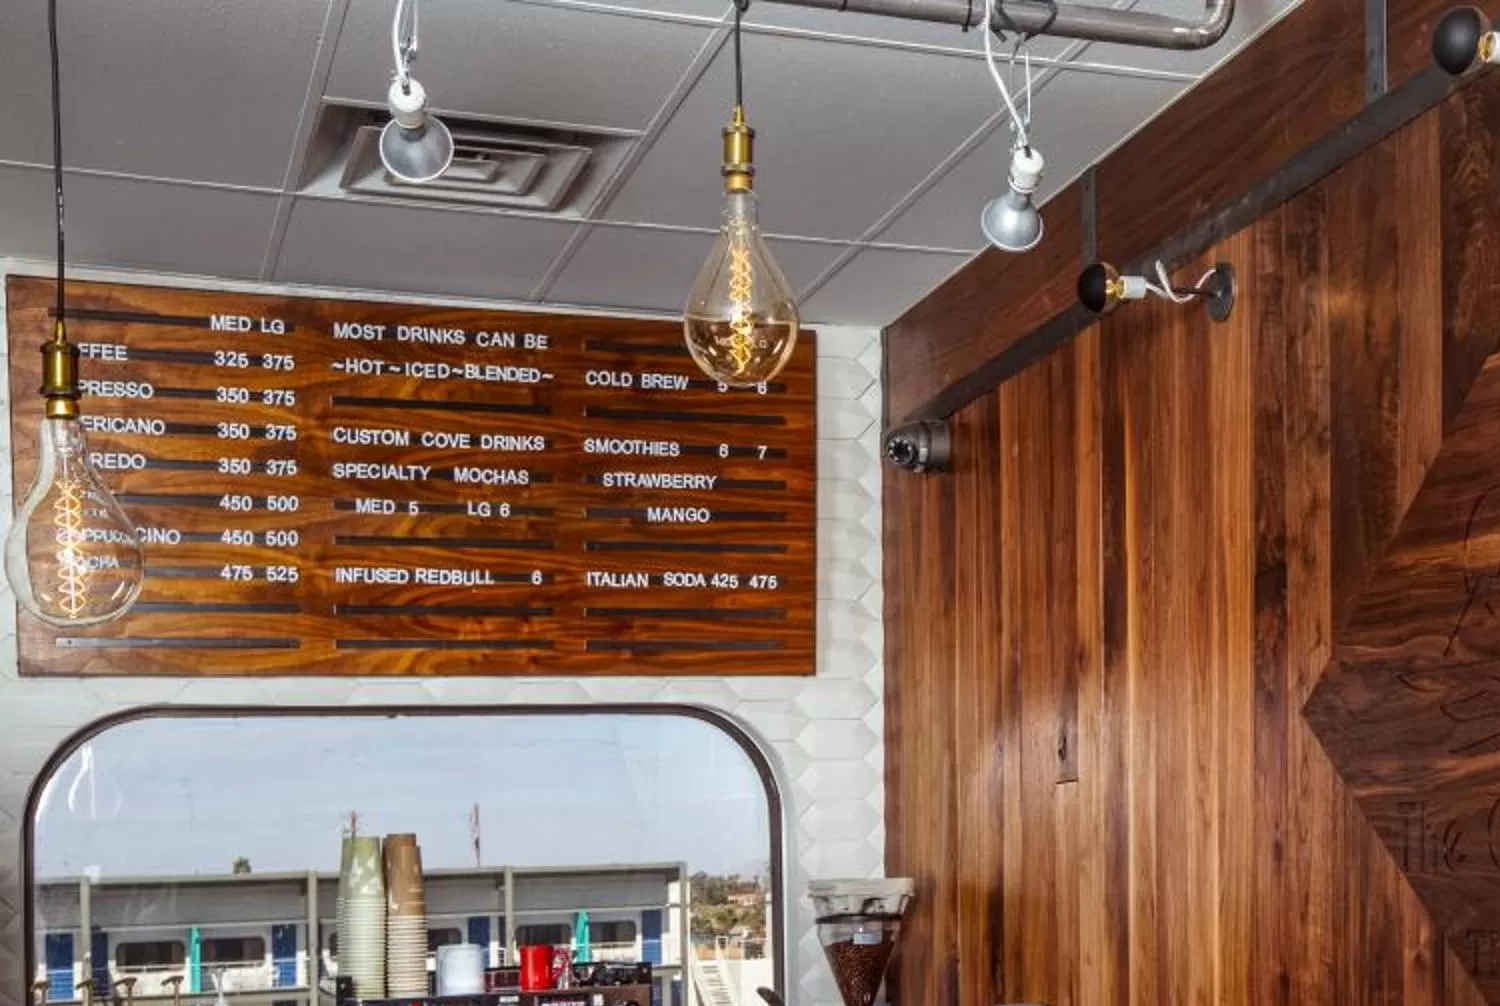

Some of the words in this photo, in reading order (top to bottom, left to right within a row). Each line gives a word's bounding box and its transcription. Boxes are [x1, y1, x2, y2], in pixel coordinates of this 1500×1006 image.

[210, 314, 250, 332] MED
[260, 317, 285, 335] LG
[333, 322, 386, 341] MOST
[397, 325, 466, 345] DRINKS
[475, 331, 516, 348] CAN
[524, 333, 548, 350] BE
[78, 342, 128, 361] FFEE
[213, 350, 249, 368] 325
[262, 353, 295, 371] 375
[584, 369, 633, 388] COLD
[641, 373, 689, 391] BREW
[78, 379, 154, 399] PRESSO
[217, 386, 249, 404] 350
[263, 388, 295, 406] 375
[81, 415, 165, 435] ERICANO
[217, 422, 250, 440] 350
[265, 424, 297, 441] 375
[332, 427, 409, 447] CUSTOM
[421, 431, 471, 449] COVE
[481, 434, 545, 451] DRINKS
[584, 437, 680, 457] SMOOTHIES
[719, 443, 729, 458] 6
[757, 445, 767, 460] 7
[89, 452, 146, 470] REDO
[218, 457, 251, 475] 350
[265, 459, 297, 477] 375
[332, 463, 432, 481] SPECIALTY
[454, 466, 529, 485] MOCHAS
[603, 471, 718, 490] STRAWBERRY
[219, 493, 252, 512] 450
[267, 494, 299, 512] 500
[355, 497, 396, 515] MED
[408, 501, 419, 516] 5
[467, 500, 491, 517] LG
[500, 503, 511, 518] 6
[647, 506, 710, 524] MANGO
[220, 528, 253, 546] 450
[220, 563, 253, 582] 475
[265, 565, 299, 583] 525
[335, 567, 409, 585] INFUSED
[415, 567, 495, 585] REDBULL
[531, 569, 543, 585] 6
[586, 571, 649, 589] ITALIAN
[663, 571, 706, 588] SODA
[711, 572, 739, 589] 425
